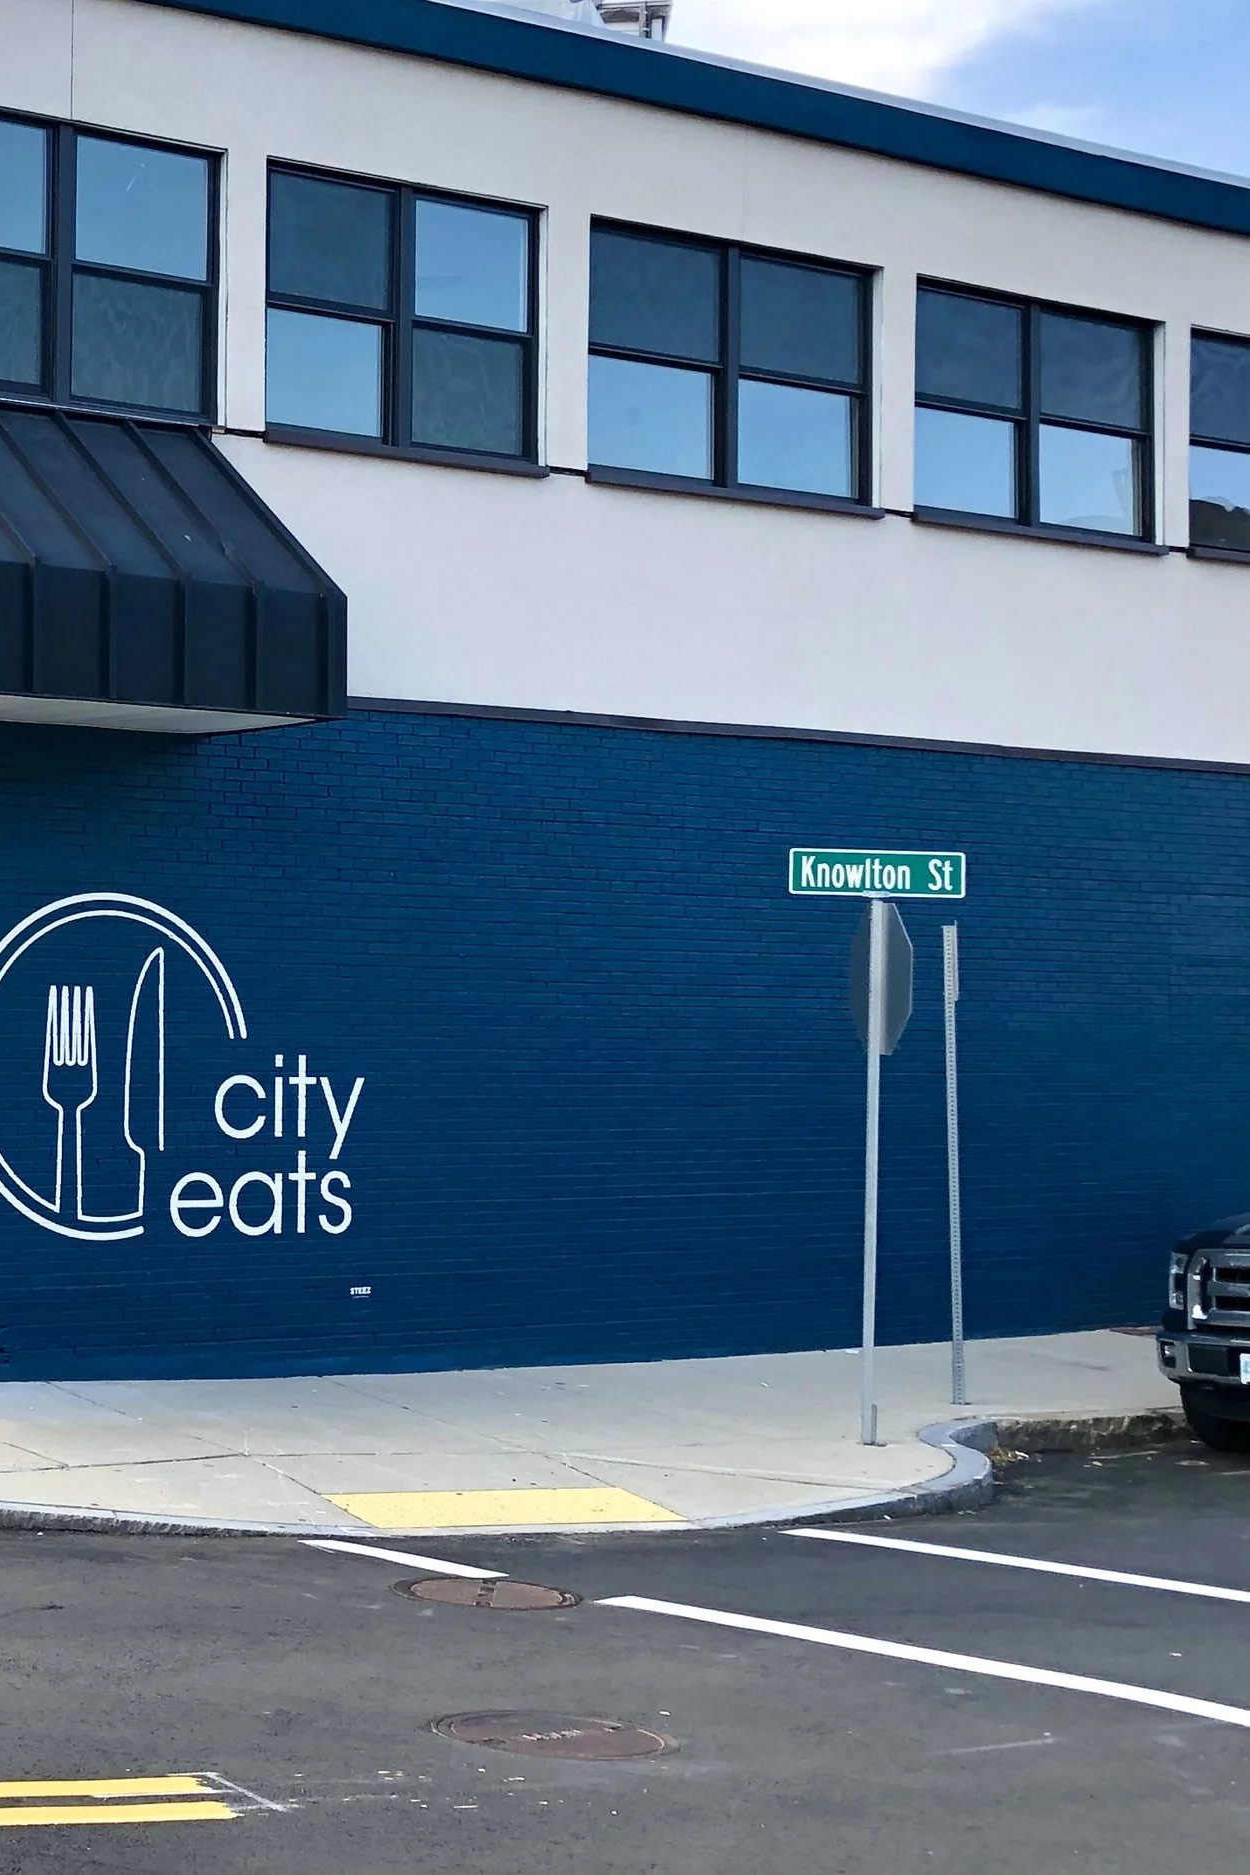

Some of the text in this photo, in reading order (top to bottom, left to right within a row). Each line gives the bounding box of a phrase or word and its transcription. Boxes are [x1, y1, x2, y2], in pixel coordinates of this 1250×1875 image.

[801, 855, 954, 891] Knowlton St
[214, 1054, 365, 1160] city
[169, 1150, 352, 1238] eats
